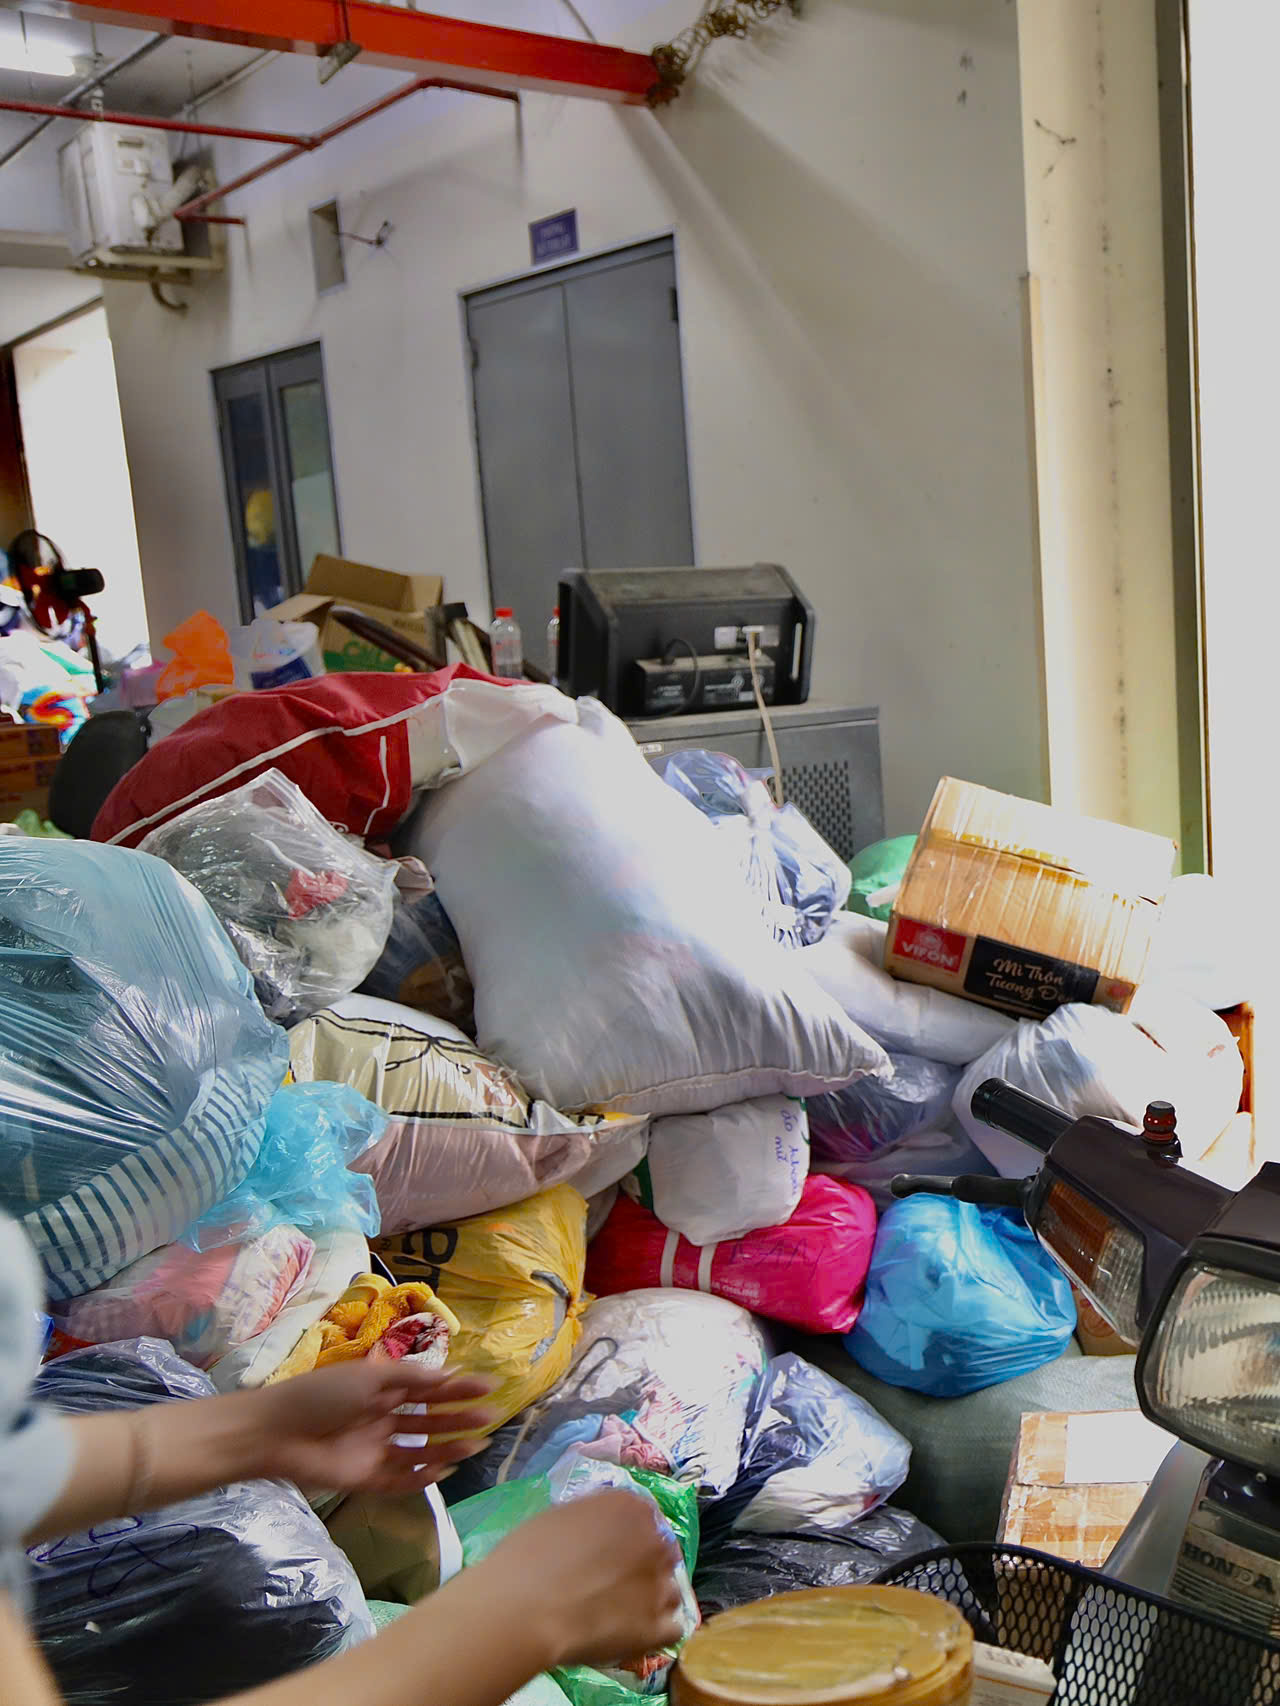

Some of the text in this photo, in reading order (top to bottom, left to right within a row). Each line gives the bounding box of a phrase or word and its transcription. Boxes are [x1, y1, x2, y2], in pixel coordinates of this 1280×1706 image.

[901, 941, 955, 967] VIFON
[993, 959, 1023, 977] Mì
[1184, 1542, 1275, 1594] HONDA
